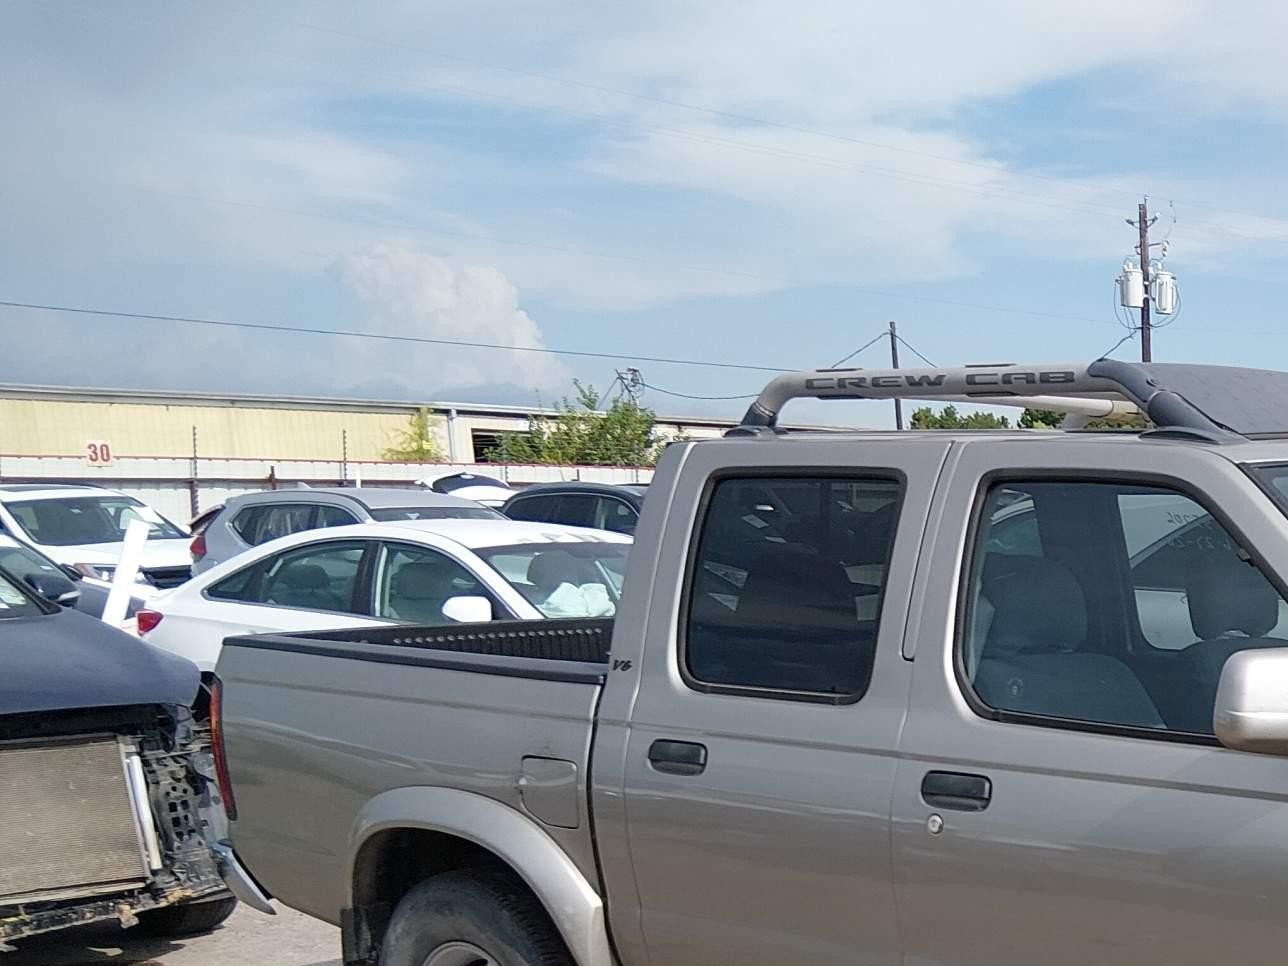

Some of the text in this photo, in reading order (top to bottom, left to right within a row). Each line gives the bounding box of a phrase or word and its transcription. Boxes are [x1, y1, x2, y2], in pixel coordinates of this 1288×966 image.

[805, 371, 1076, 390] CREW CAB
[88, 443, 110, 462] 30
[613, 660, 632, 671] V6
